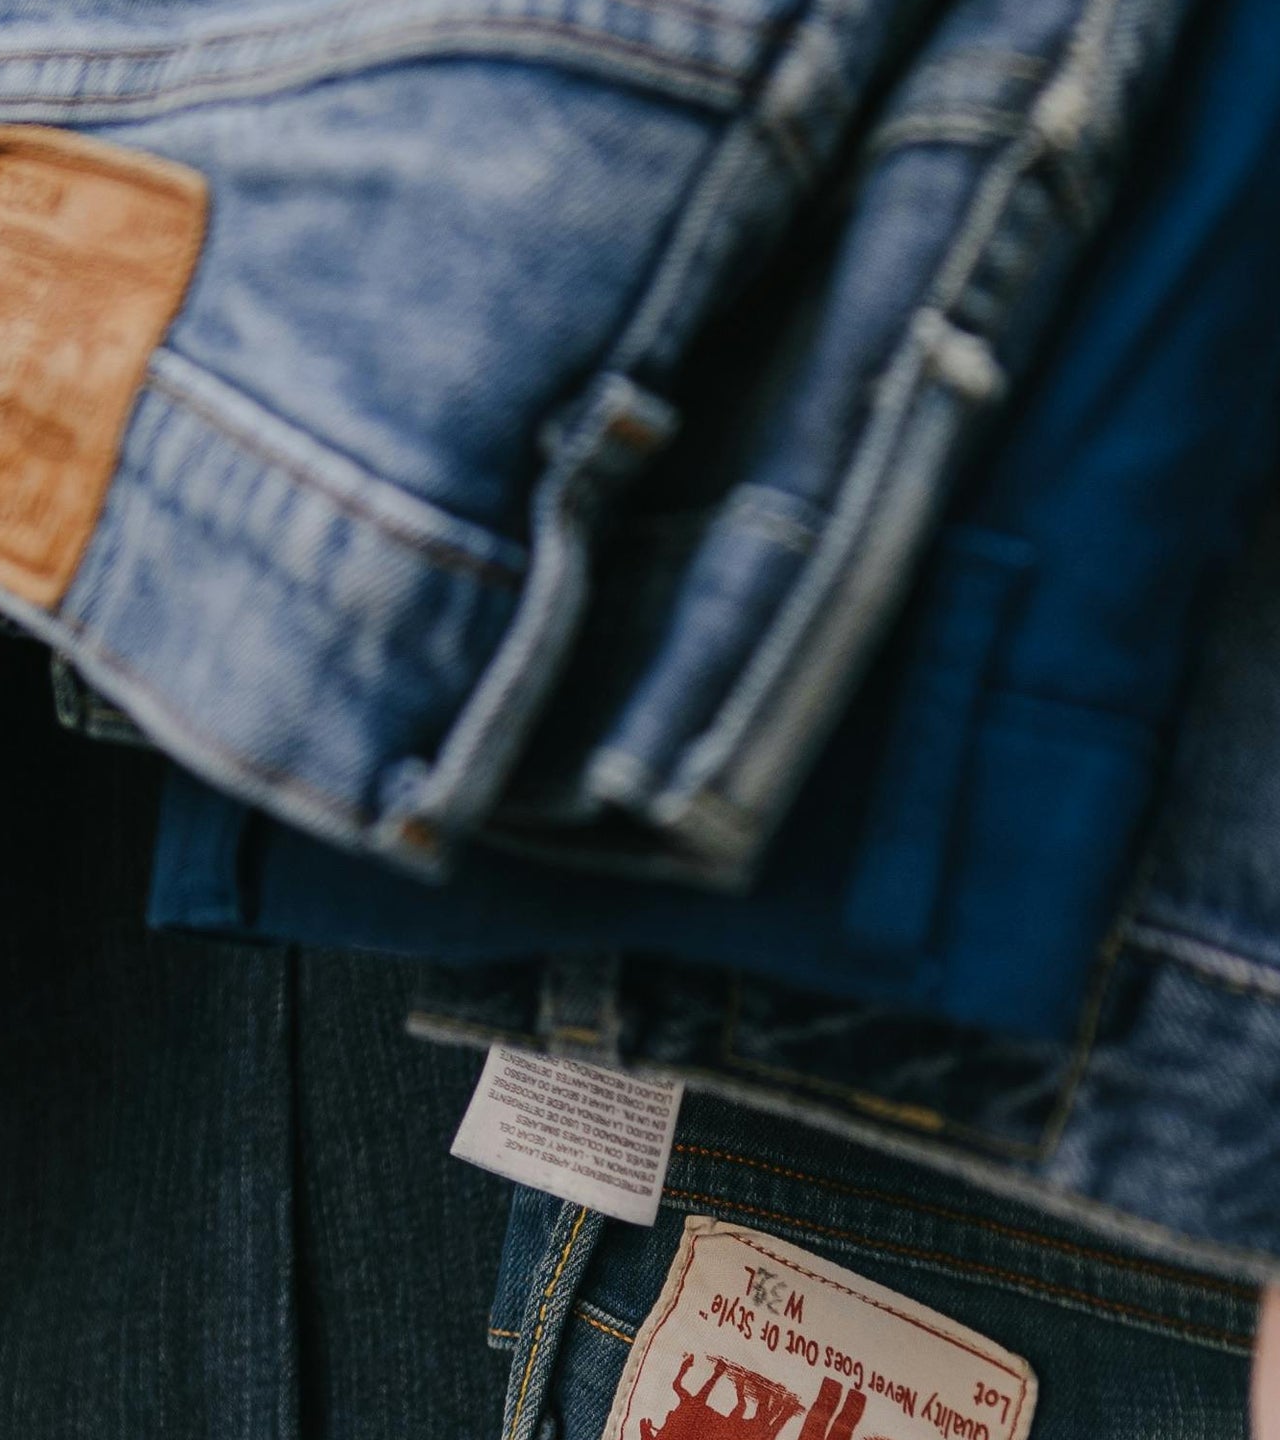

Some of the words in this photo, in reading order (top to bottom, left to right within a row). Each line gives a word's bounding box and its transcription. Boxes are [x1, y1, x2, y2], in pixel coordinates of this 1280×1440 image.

[500, 1048, 552, 1078] DETERGENTE
[504, 1067, 537, 1085] AVESSO
[494, 1076, 545, 1104] ENCOGERSE
[538, 1080, 550, 1091] DO
[551, 1087, 579, 1102] SECAR
[617, 1094, 644, 1110] CORES
[488, 1089, 545, 1118] DETERGENTE
[546, 1097, 575, 1114] PUEDE
[588, 1098, 615, 1113] LAVAR
[646, 1105, 670, 1117] COM
[516, 1114, 560, 1136] SIMILARES
[546, 1111, 559, 1122] DE
[560, 1116, 579, 1128] USO
[578, 1108, 610, 1127] PRENDA
[638, 1116, 648, 1124] UN
[652, 1120, 666, 1130] EN
[500, 1122, 516, 1135] DEL
[582, 1122, 592, 1134] EL
[517, 1130, 546, 1146] SECAR
[562, 1131, 603, 1152] COLORES
[593, 1128, 660, 1156] RECOMENDADO
[506, 1139, 540, 1156] LAVAGE
[556, 1144, 584, 1157] LAVAR
[605, 1146, 622, 1158] CON
[744, 1265, 756, 1297] L
[784, 1290, 805, 1325] W
[785, 1329, 819, 1367] Out
[824, 1345, 864, 1390] Goes
[868, 1371, 918, 1419] Never
[972, 1381, 1010, 1425] Lot
